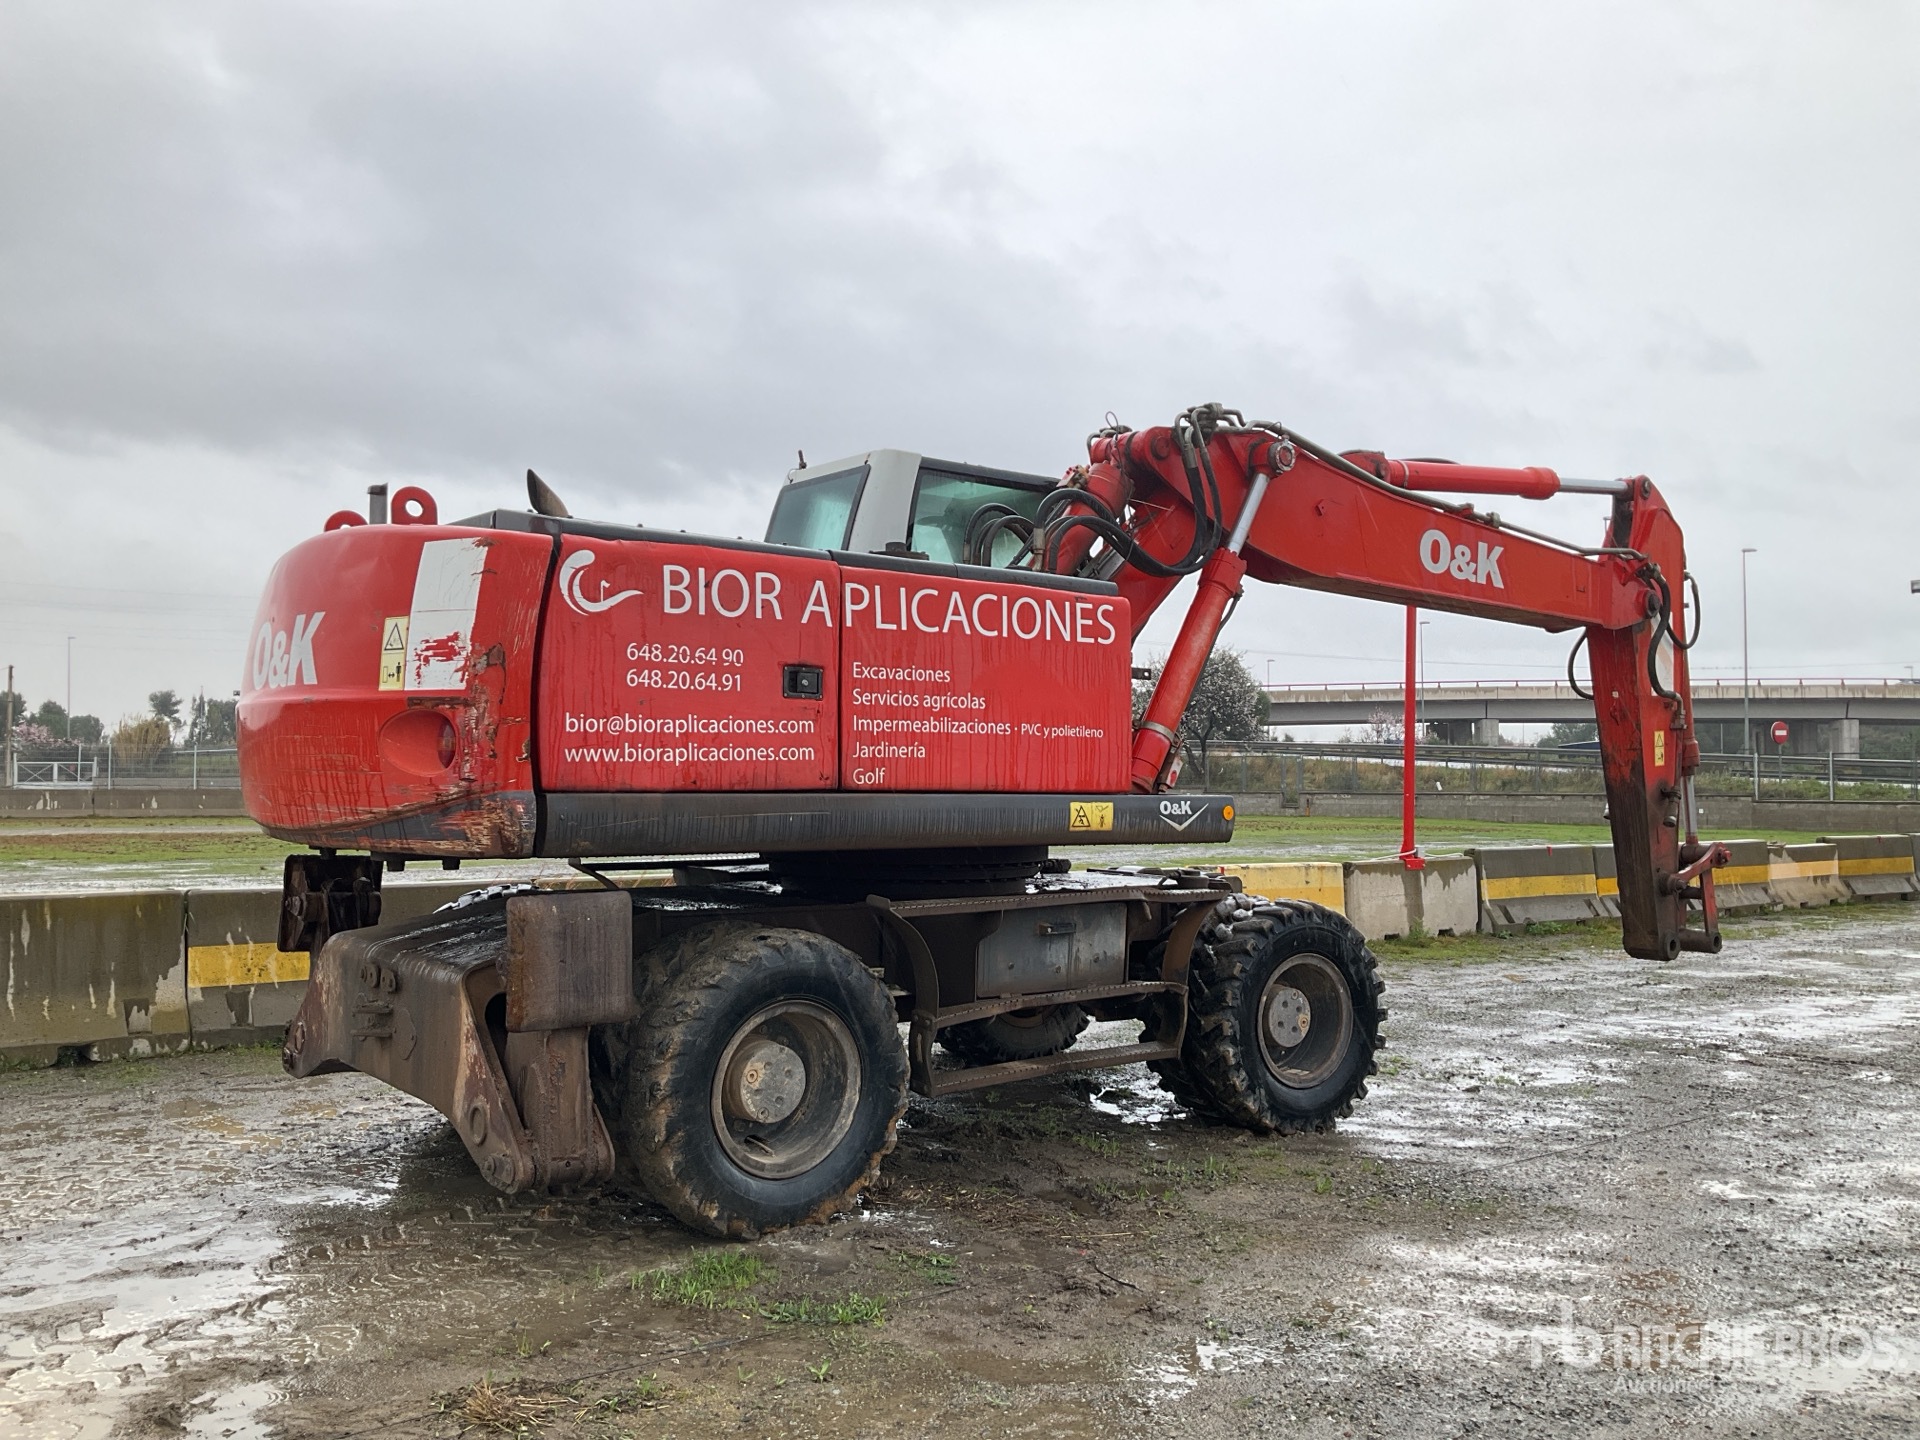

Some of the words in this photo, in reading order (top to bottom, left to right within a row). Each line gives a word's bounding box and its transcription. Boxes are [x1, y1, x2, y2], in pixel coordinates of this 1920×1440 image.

[1420, 529, 1504, 589] O&K
[663, 564, 782, 621] BIOR
[253, 611, 326, 691] O&K
[626, 668, 741, 692] 648.20.64.91
[853, 662, 951, 682] Excavaciones
[852, 689, 919, 707] Servicios
[923, 692, 986, 711] agrícolas
[565, 712, 815, 738] bior@bioraplicaciones.com
[853, 715, 1011, 735] Impermeabilizaciones
[1021, 723, 1042, 736] PVC
[1043, 728, 1051, 739] y
[1051, 725, 1104, 739] polietileno
[564, 743, 815, 766] www.bioraplicaciones.com
[853, 742, 926, 758] Jardinería
[853, 768, 886, 785] Golf
[1159, 801, 1193, 815] O&K
